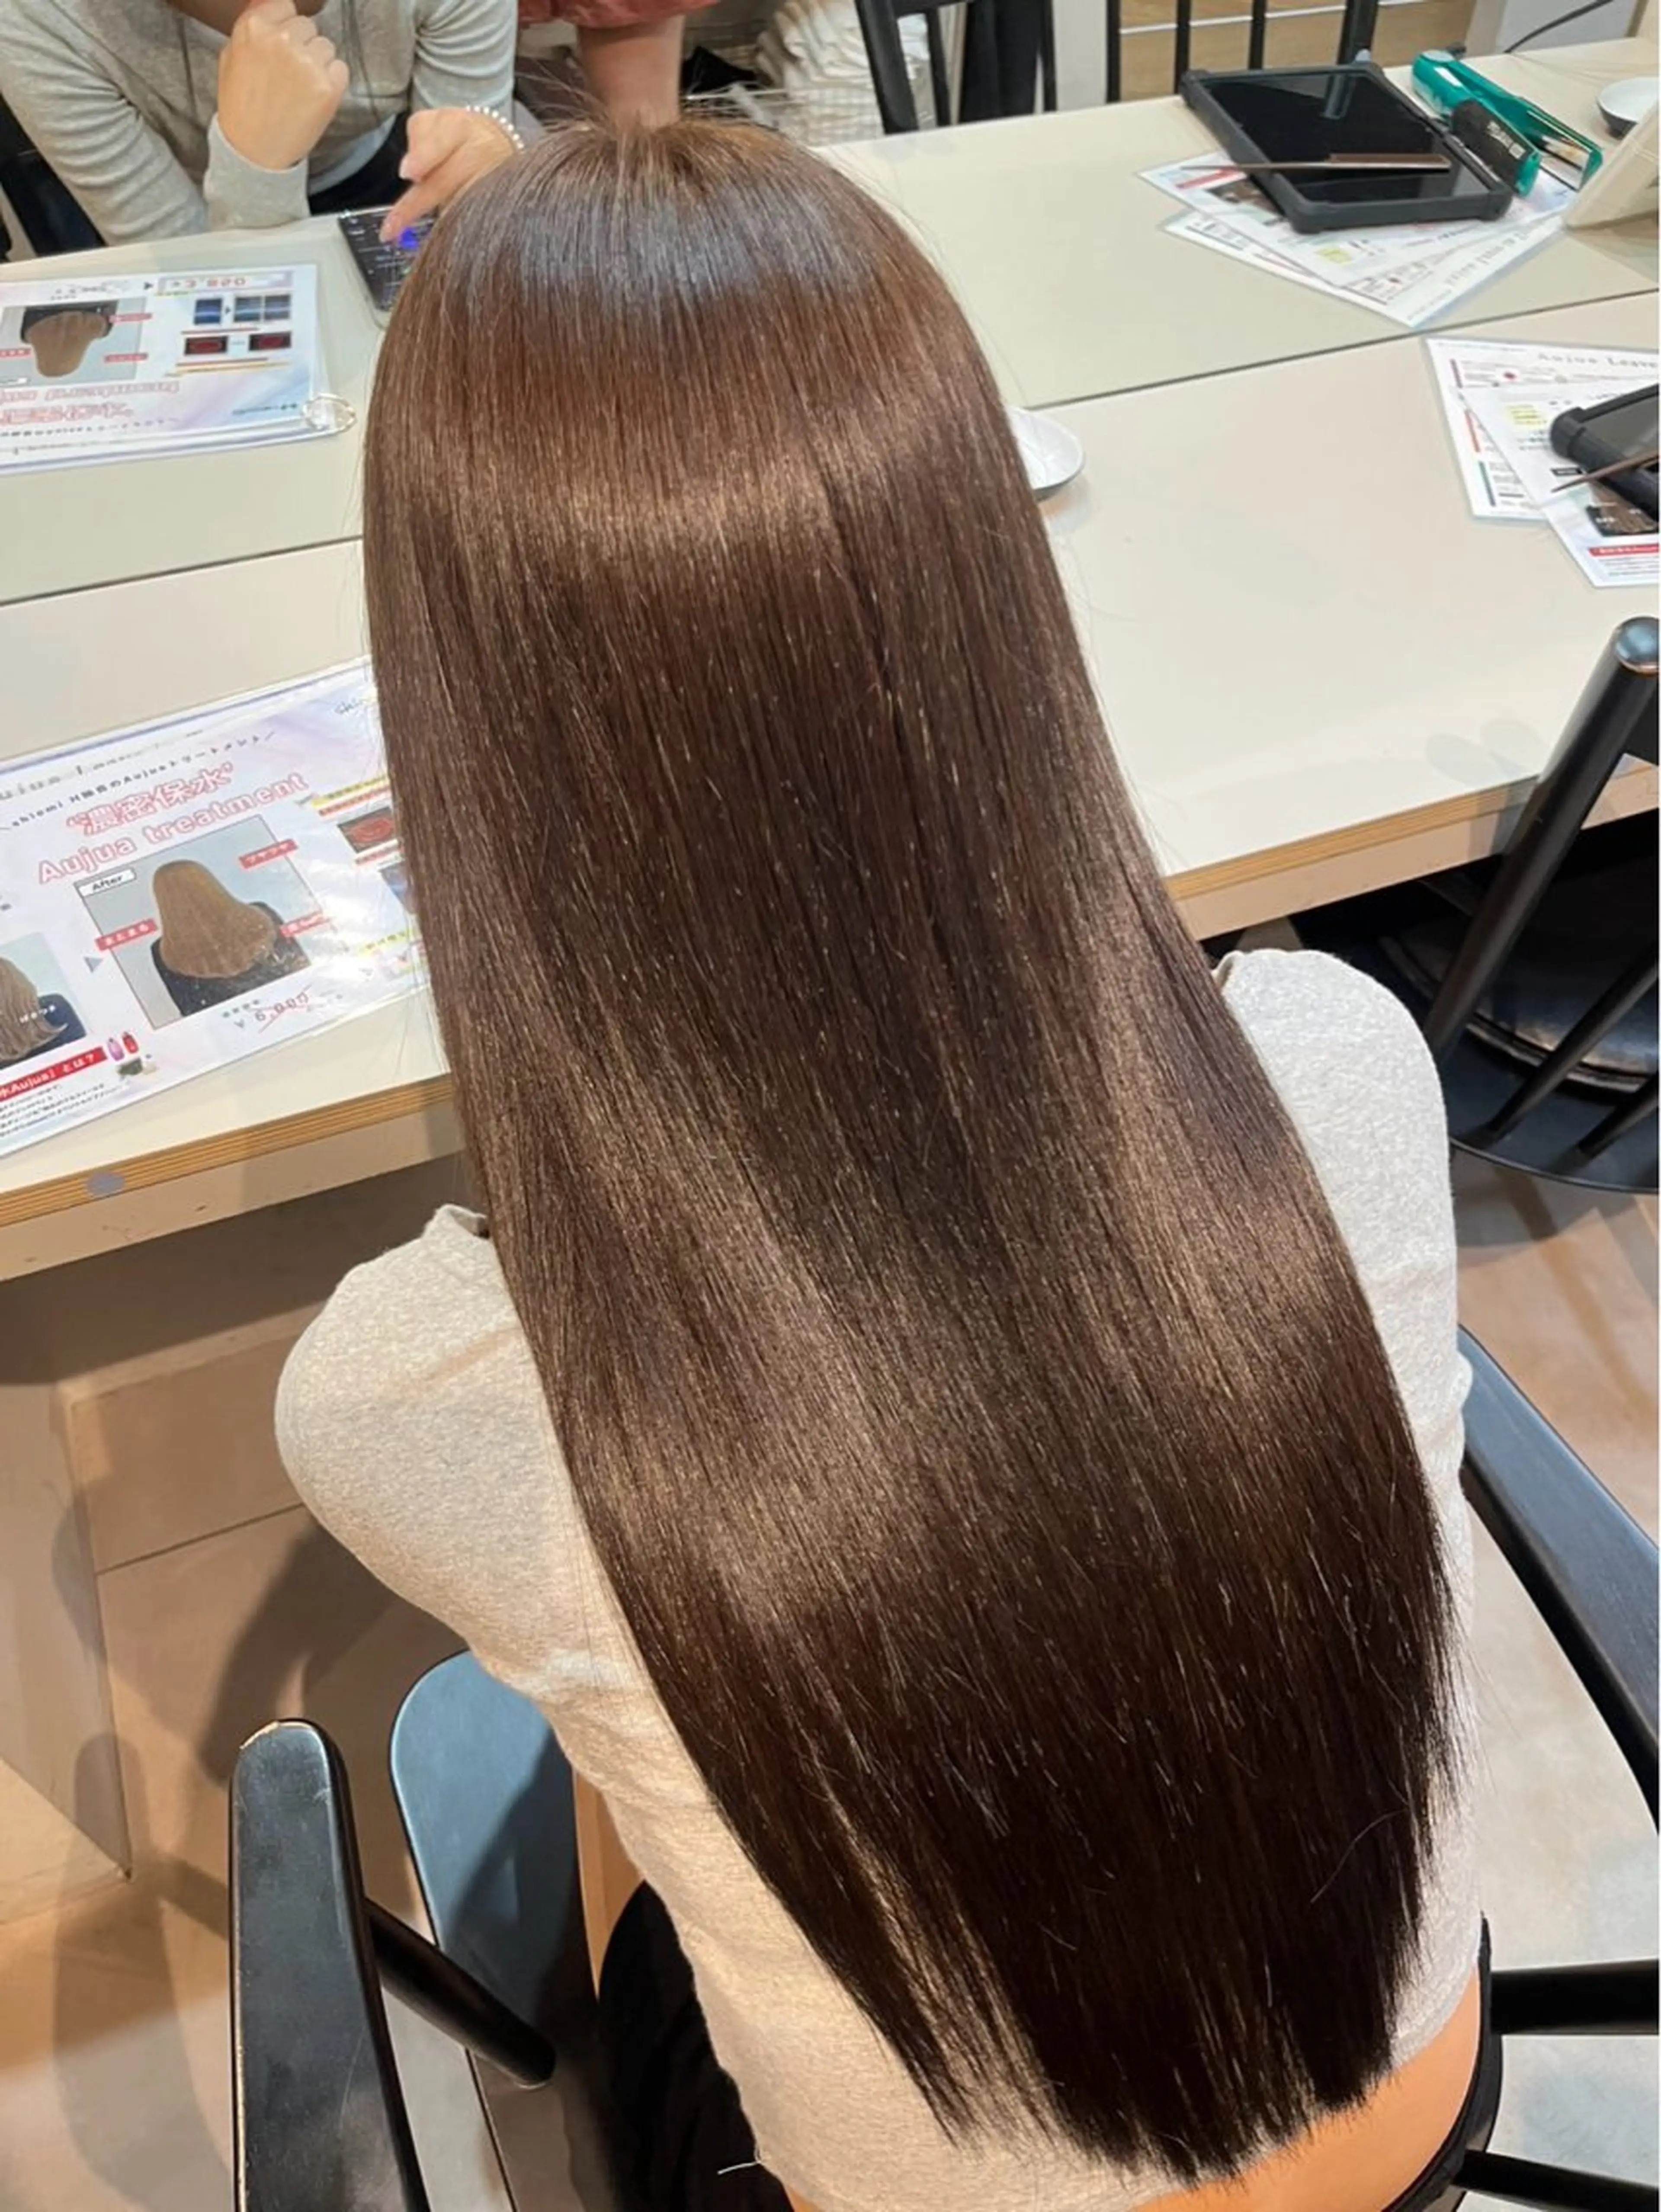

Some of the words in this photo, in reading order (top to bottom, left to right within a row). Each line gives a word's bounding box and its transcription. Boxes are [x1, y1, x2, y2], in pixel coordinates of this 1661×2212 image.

[38, 837, 138, 884] Aujua
[143, 772, 309, 844] treatment
[92, 875, 123, 891] After
